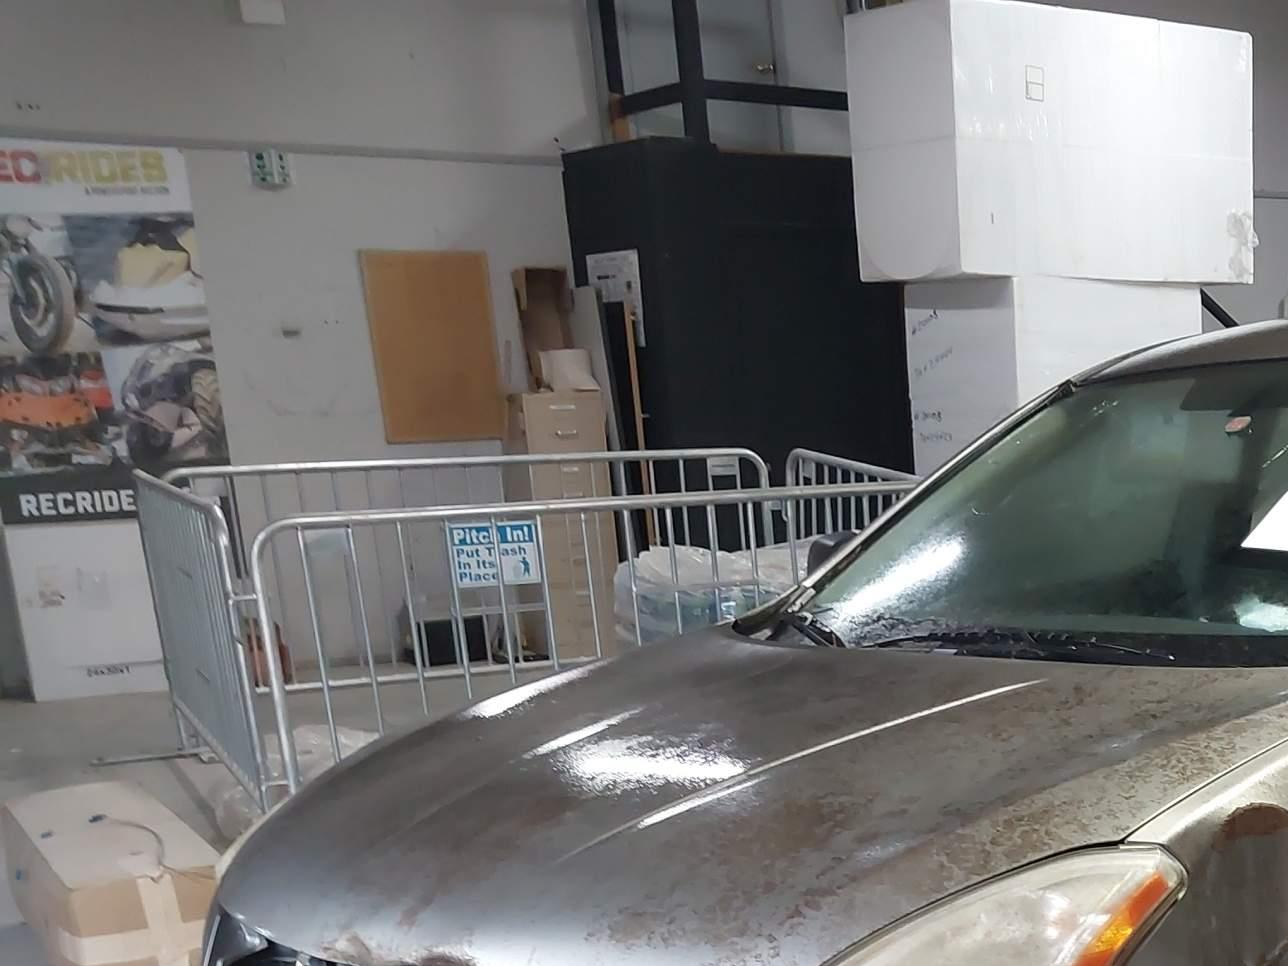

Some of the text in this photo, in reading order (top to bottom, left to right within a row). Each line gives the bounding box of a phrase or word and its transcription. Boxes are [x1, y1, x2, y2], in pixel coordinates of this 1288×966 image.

[18, 489, 137, 516] RECRIDE
[506, 526, 530, 542] In!
[455, 545, 527, 559] Put Tash
[457, 559, 496, 571] In Its
